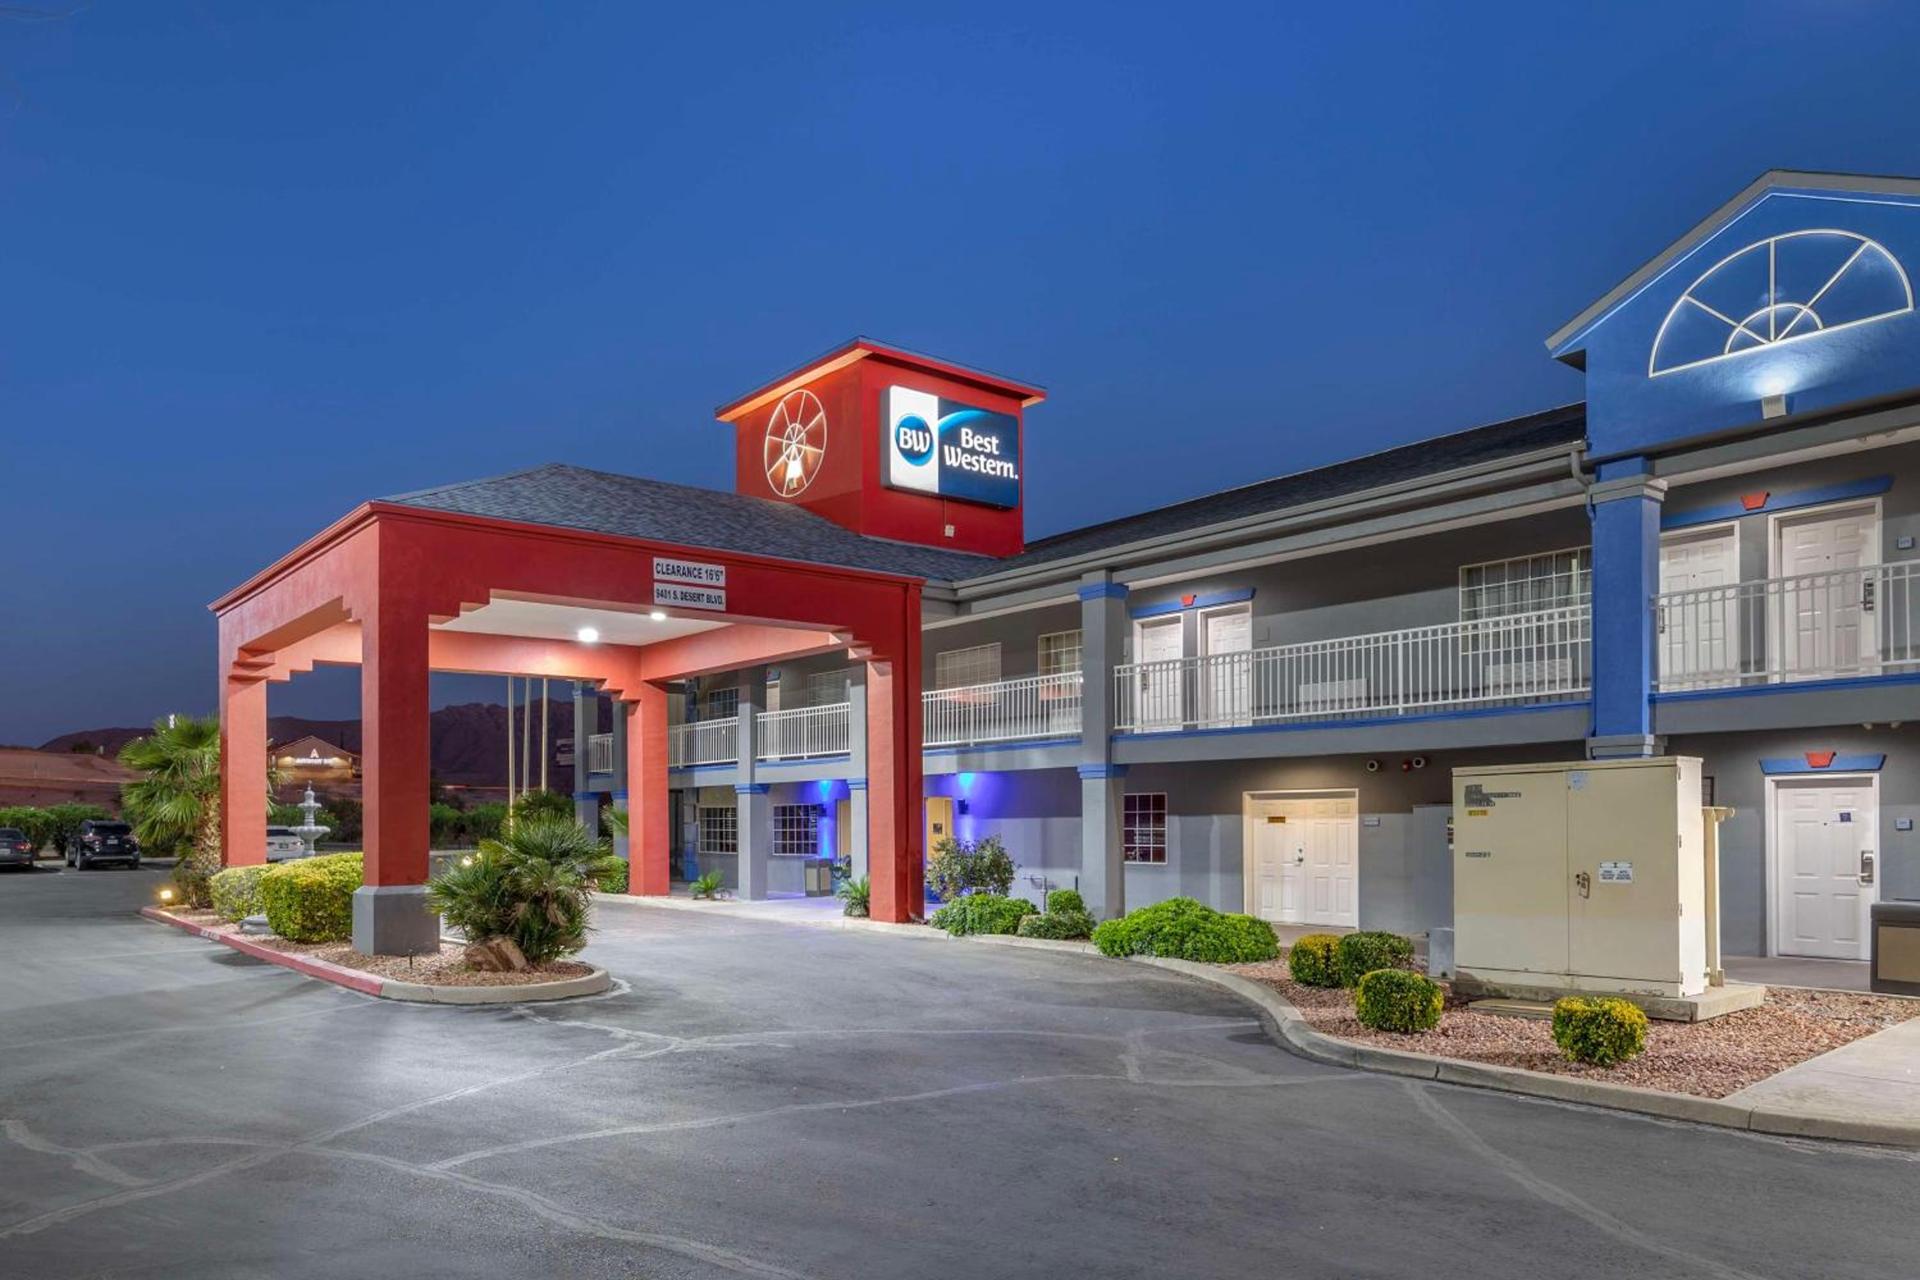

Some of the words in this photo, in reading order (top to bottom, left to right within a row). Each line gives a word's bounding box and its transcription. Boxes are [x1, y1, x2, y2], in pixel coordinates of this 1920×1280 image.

[961, 427, 999, 454] Best
[655, 562, 703, 579] CLEARANCE
[680, 591, 705, 603] DESERT
